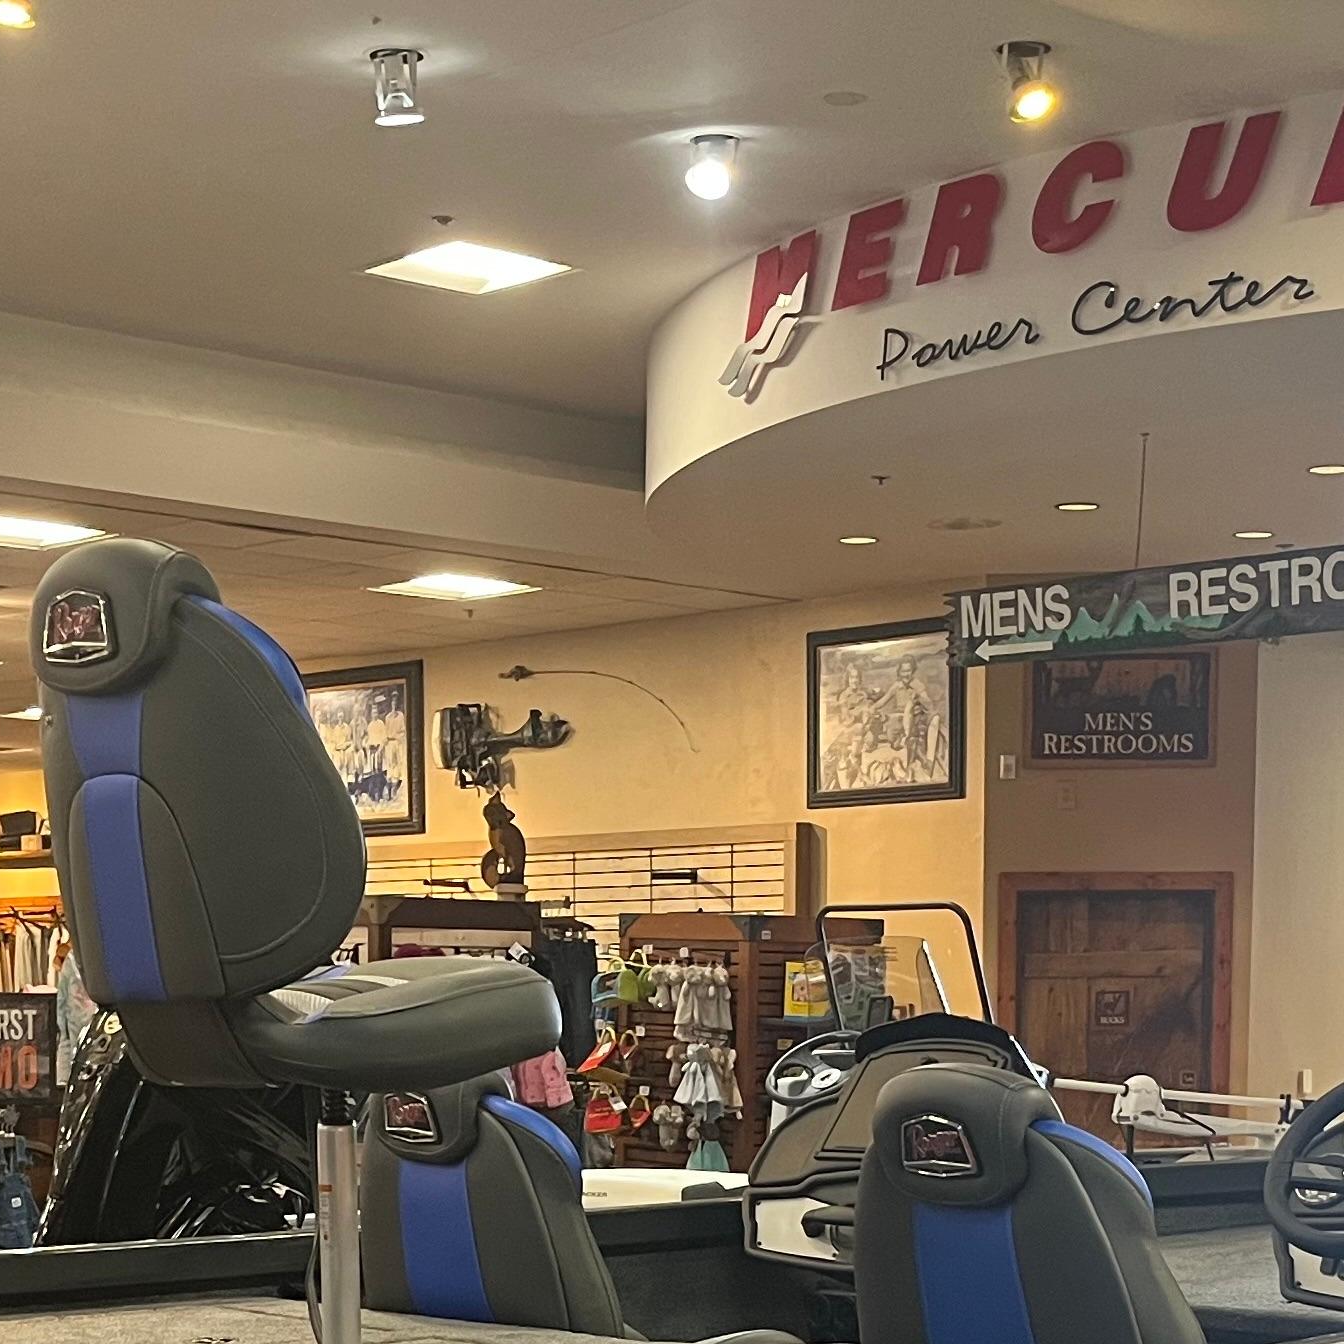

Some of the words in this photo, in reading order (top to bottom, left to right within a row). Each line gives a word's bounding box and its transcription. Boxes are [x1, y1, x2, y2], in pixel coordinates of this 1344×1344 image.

[874, 313, 1040, 382] Power
[1070, 270, 1315, 336] Center
[961, 584, 1073, 638] MENS
[1084, 711, 1153, 732] MEN'S
[1043, 732, 1194, 755] RESTROOMS
